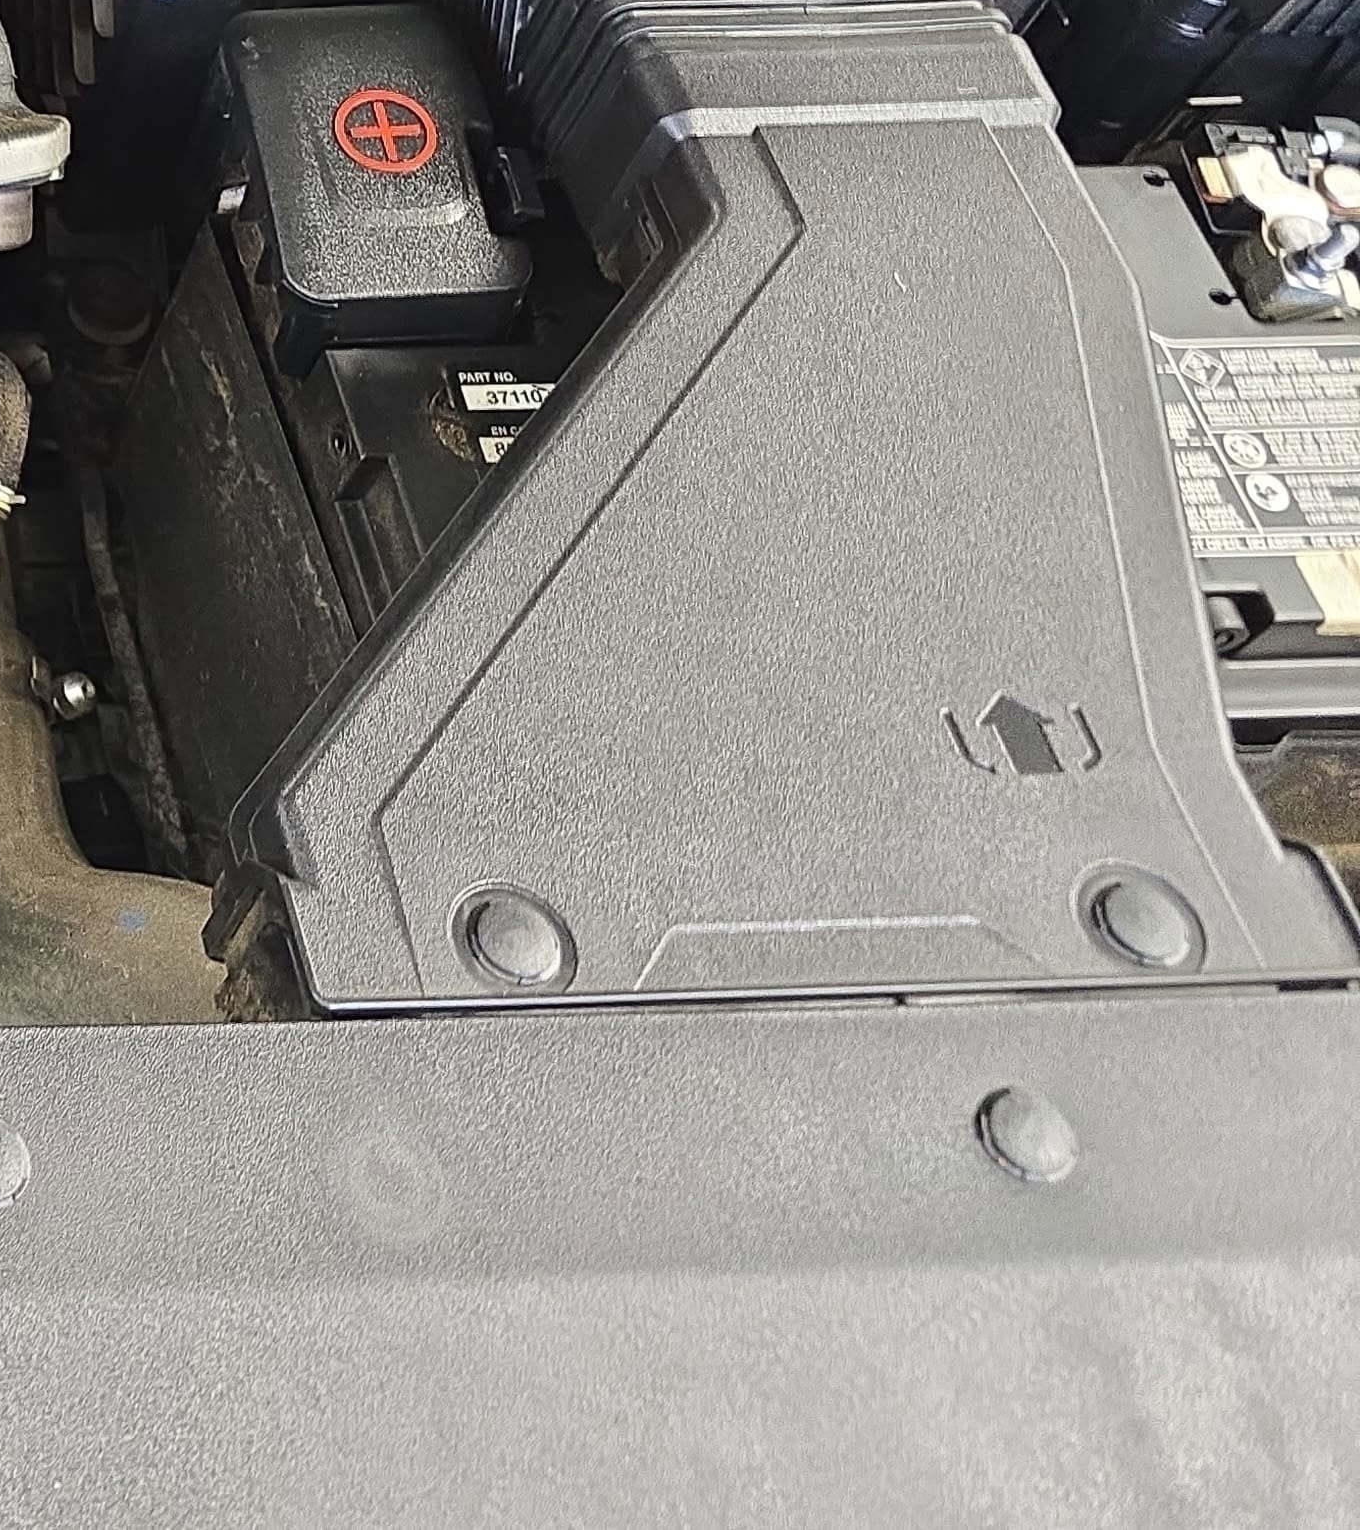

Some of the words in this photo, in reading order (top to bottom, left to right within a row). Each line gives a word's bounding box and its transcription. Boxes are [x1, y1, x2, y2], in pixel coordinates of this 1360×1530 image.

[458, 372, 490, 384] PART
[493, 372, 518, 384] NO.
[490, 426, 508, 437] EN
